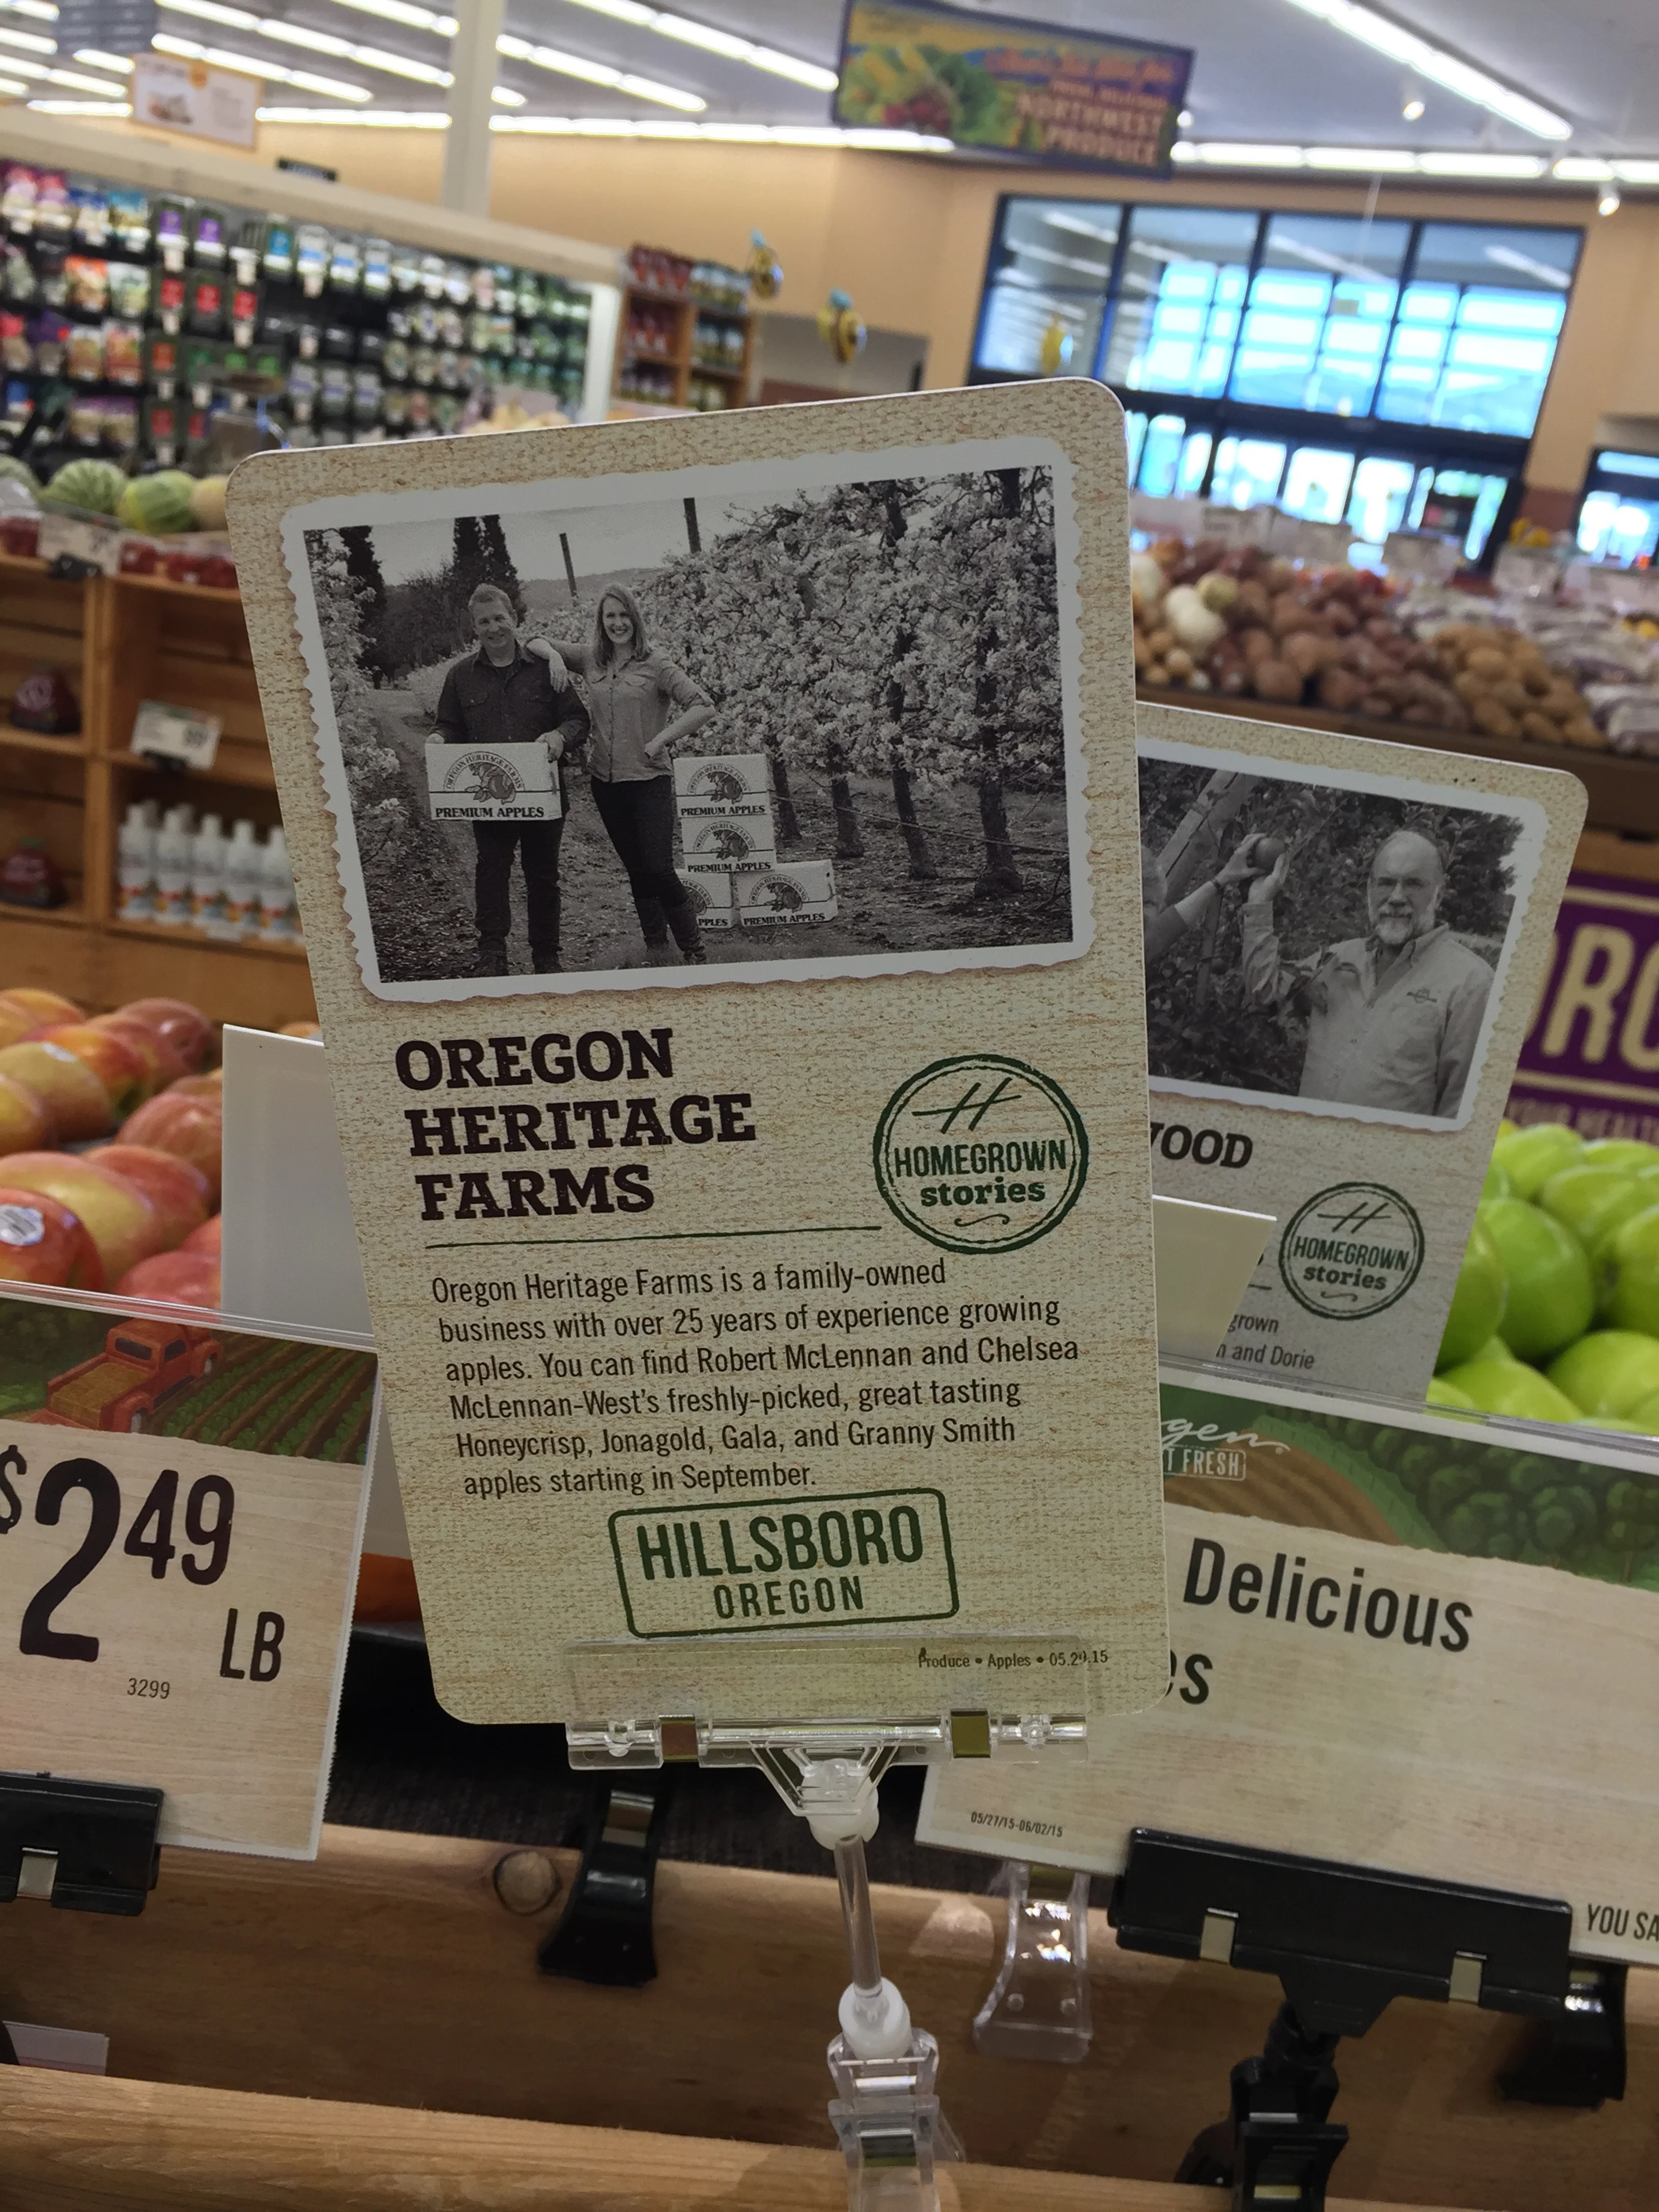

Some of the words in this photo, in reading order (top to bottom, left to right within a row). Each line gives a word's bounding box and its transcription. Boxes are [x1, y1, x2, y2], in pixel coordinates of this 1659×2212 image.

[436, 807, 493, 818] PREMIUM
[497, 807, 544, 818] APPLES
[681, 806, 726, 816] PREMIUM
[728, 805, 765, 814] APPLES
[688, 863, 732, 872] PREMIUM
[735, 862, 771, 871] APPLES
[698, 918, 728, 926] PPLES
[744, 915, 787, 926] PREMIUM
[790, 913, 825, 923] APPLES
[395, 1028, 673, 1090] OREGON
[405, 1093, 756, 1156] HERITAGE
[894, 1140, 1066, 1178] HOMEGROWN
[415, 1164, 654, 1220] FARMS
[920, 1176, 1046, 1207] stories
[1293, 1236, 1410, 1272] HOMEGROWN
[432, 1276, 516, 1307] Oregon
[525, 1272, 628, 1302] Heritage
[636, 1269, 713, 1296] Farms
[722, 1266, 743, 1292] is
[753, 1271, 766, 1291] a
[776, 1258, 946, 1294] family-owned
[1303, 1264, 1387, 1291] stories
[439, 1317, 546, 1343] business
[554, 1312, 605, 1338] with
[614, 1314, 663, 1337] over
[673, 1308, 703, 1335] 25
[712, 1309, 777, 1339] years
[786, 1304, 808, 1330] of
[817, 1301, 949, 1333] experience
[960, 1295, 1060, 1328] growing
[446, 1357, 532, 1386] apples.
[539, 1353, 582, 1377] You
[591, 1354, 633, 1376] can
[641, 1349, 688, 1374] find
[697, 1345, 776, 1372] Robert
[786, 1339, 912, 1370] McLennan
[921, 1338, 969, 1365] and
[977, 1336, 1079, 1363] Chelsea
[1232, 1343, 1267, 1363] and
[1271, 1345, 1315, 1370] Dorie
[449, 1389, 660, 1420] McLennan-West's
[666, 1383, 849, 1416] freshly-picked,
[858, 1381, 921, 1412] great
[930, 1380, 1021, 1407] tasting
[457, 1430, 593, 1461] Honeycrisp,
[600, 1427, 713, 1457] Jonagold,
[722, 1424, 785, 1452] Gala,
[794, 1422, 839, 1448] and
[848, 1421, 935, 1449] Granny
[943, 1416, 1015, 1442] Smith
[465, 1469, 542, 1500] apples
[550, 1468, 643, 1496] starting
[652, 1464, 673, 1490] in
[681, 1462, 816, 1493] September.
[1183, 1449, 1239, 1477] FRESH
[637, 1505, 923, 1580] HILLSBORO
[713, 1575, 864, 1620] OREGON
[1183, 1537, 1473, 1653] Delicious
[220, 1608, 285, 1682] LB
[918, 1654, 970, 1669] Produce
[988, 1652, 1031, 1670] Apples
[127, 1677, 171, 1700] 3299
[971, 1811, 1063, 1838] 05/27/15-06/02/15
[1587, 1903, 1630, 1937] YOU
